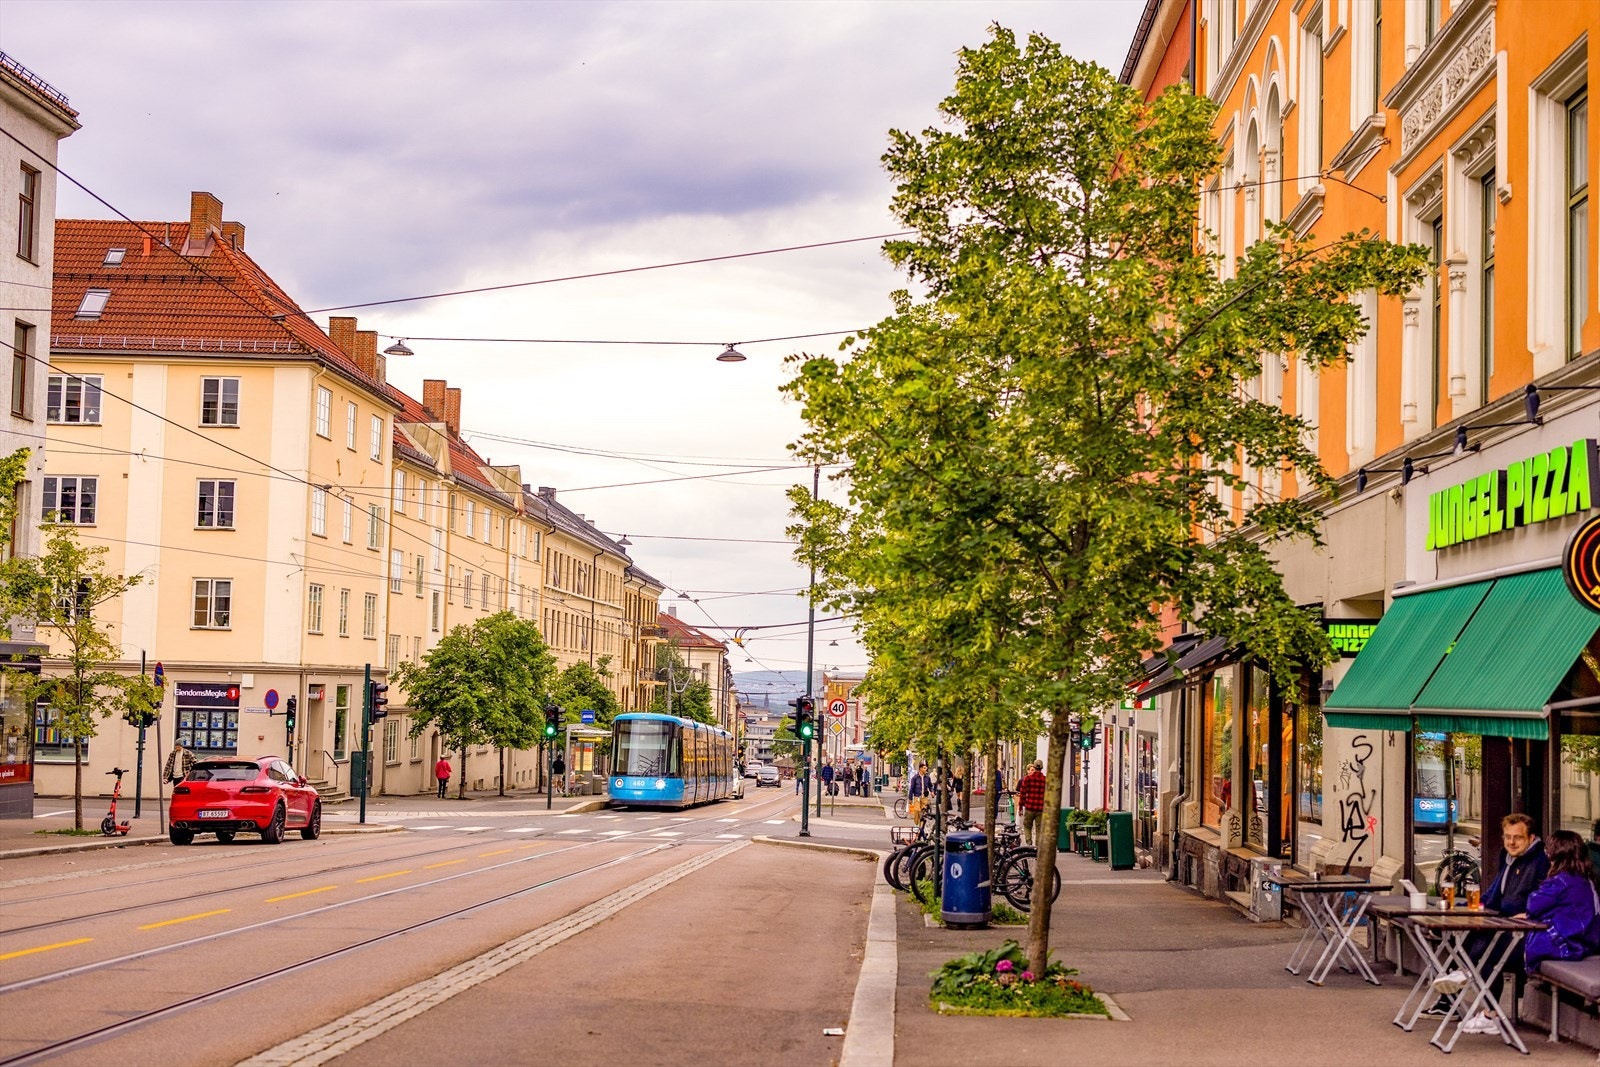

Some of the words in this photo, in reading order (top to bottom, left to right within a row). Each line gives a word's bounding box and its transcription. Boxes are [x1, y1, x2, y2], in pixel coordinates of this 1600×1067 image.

[1425, 470, 1504, 551] JUNGEL
[1506, 438, 1591, 529] PIZZA
[832, 703, 844, 712] 40
